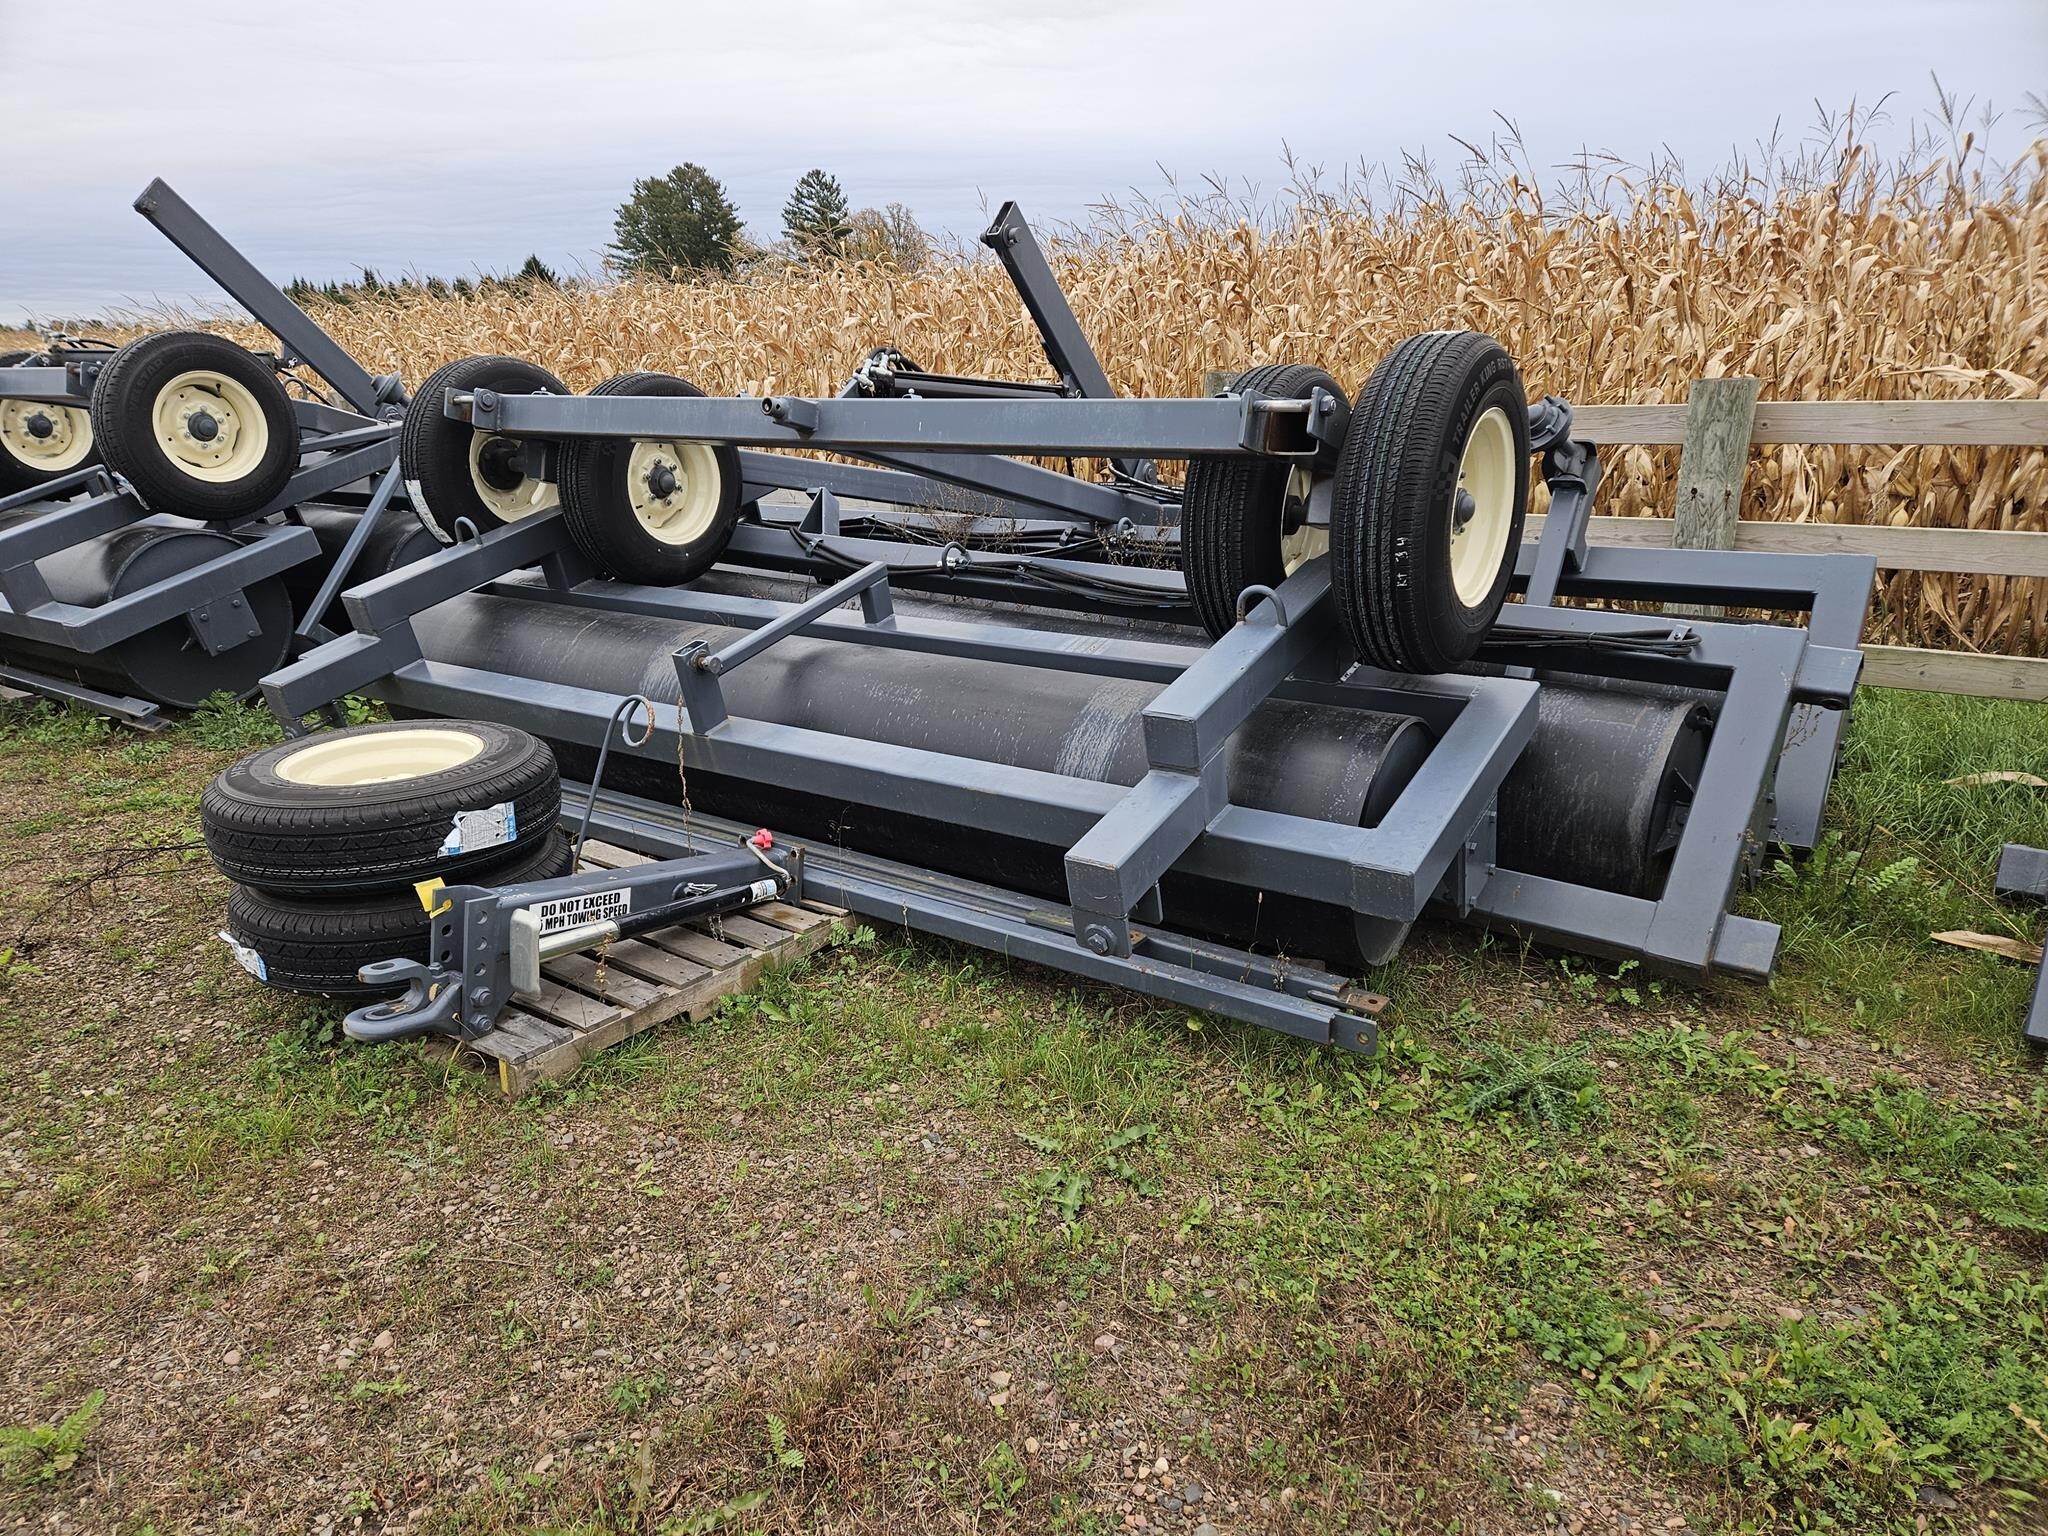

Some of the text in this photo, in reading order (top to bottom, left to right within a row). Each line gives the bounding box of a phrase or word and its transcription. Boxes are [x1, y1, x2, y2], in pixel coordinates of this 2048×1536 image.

[1452, 381, 1480, 444] TRAILER
[1480, 360, 1497, 386] KING
[541, 892, 621, 918] DO NOT EXCEED
[545, 915, 566, 931] MPH
[567, 908, 602, 926] TOWING
[603, 903, 628, 919] SPEED
